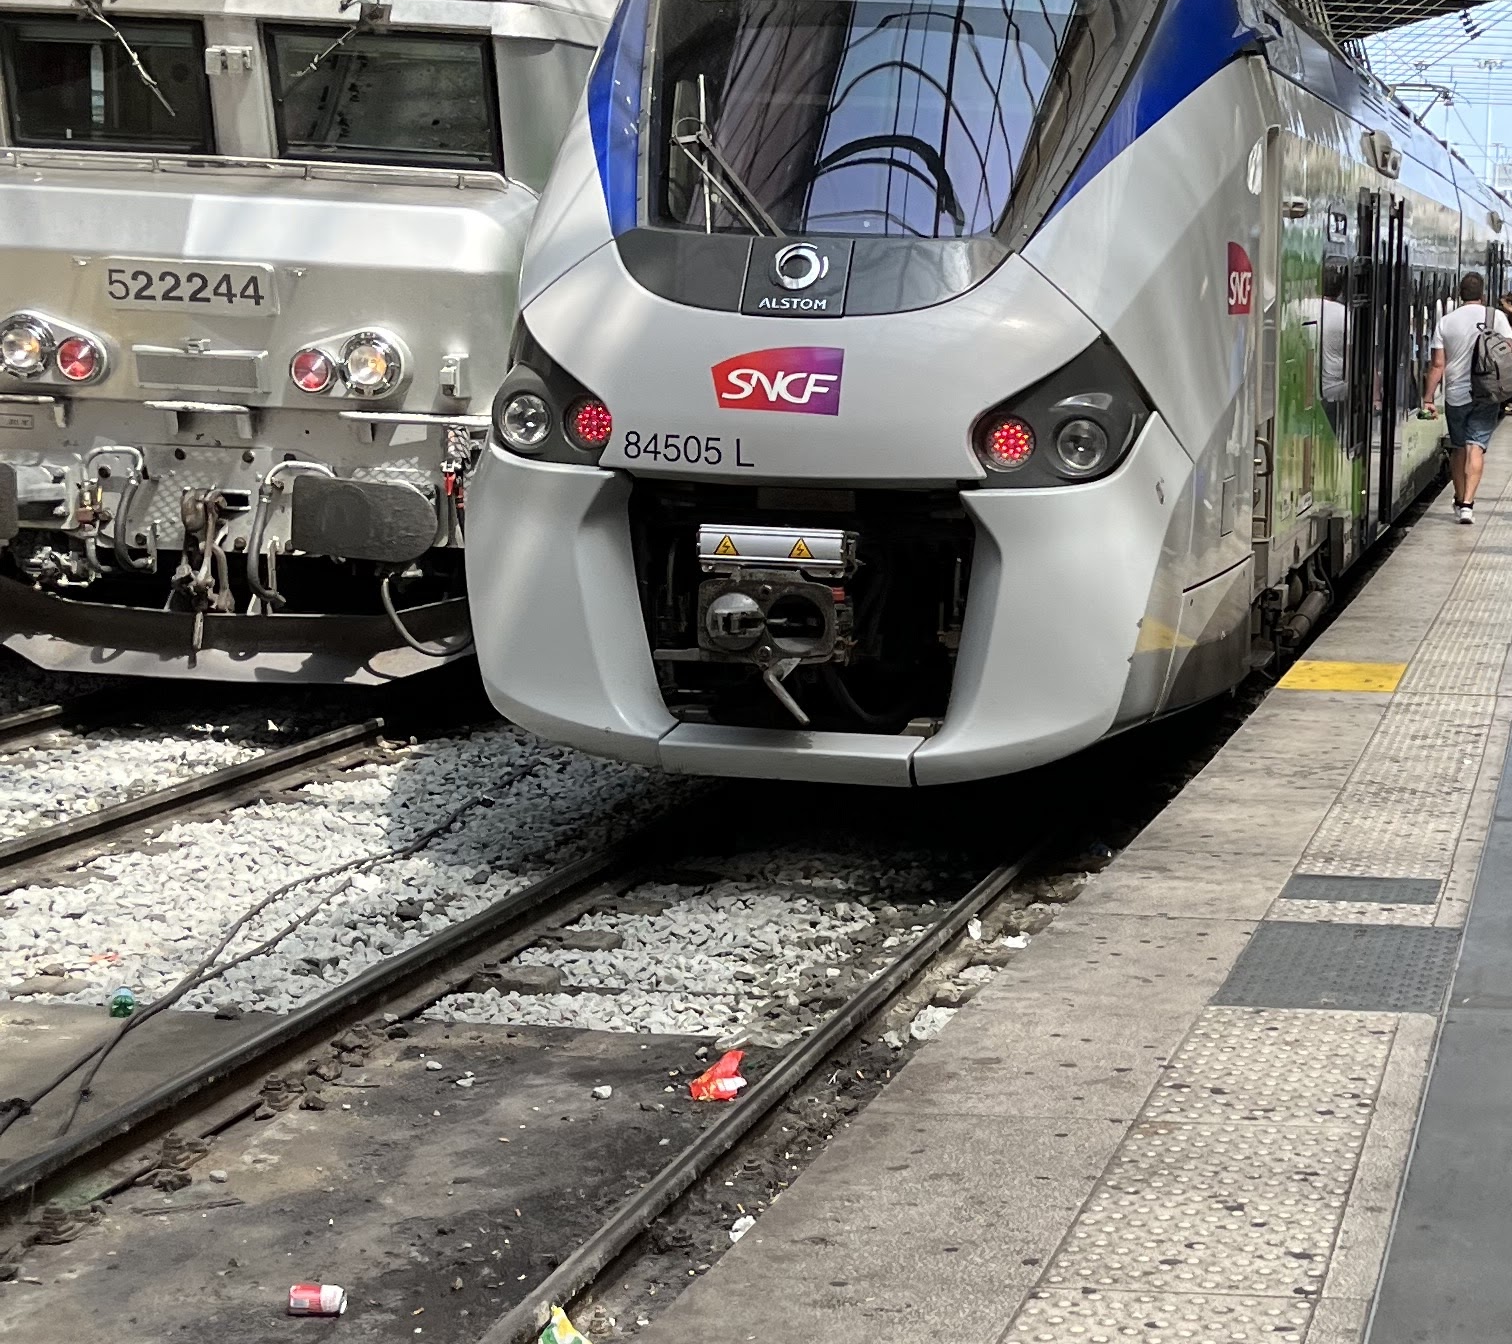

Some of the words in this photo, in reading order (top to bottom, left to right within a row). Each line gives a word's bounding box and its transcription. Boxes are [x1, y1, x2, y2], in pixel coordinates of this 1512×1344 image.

[107, 268, 265, 306] 522244
[759, 297, 828, 310] ALSTOM
[1228, 271, 1252, 305] SNCF
[721, 368, 838, 404] SNCF
[624, 430, 722, 465] 84505
[736, 438, 755, 467] L
